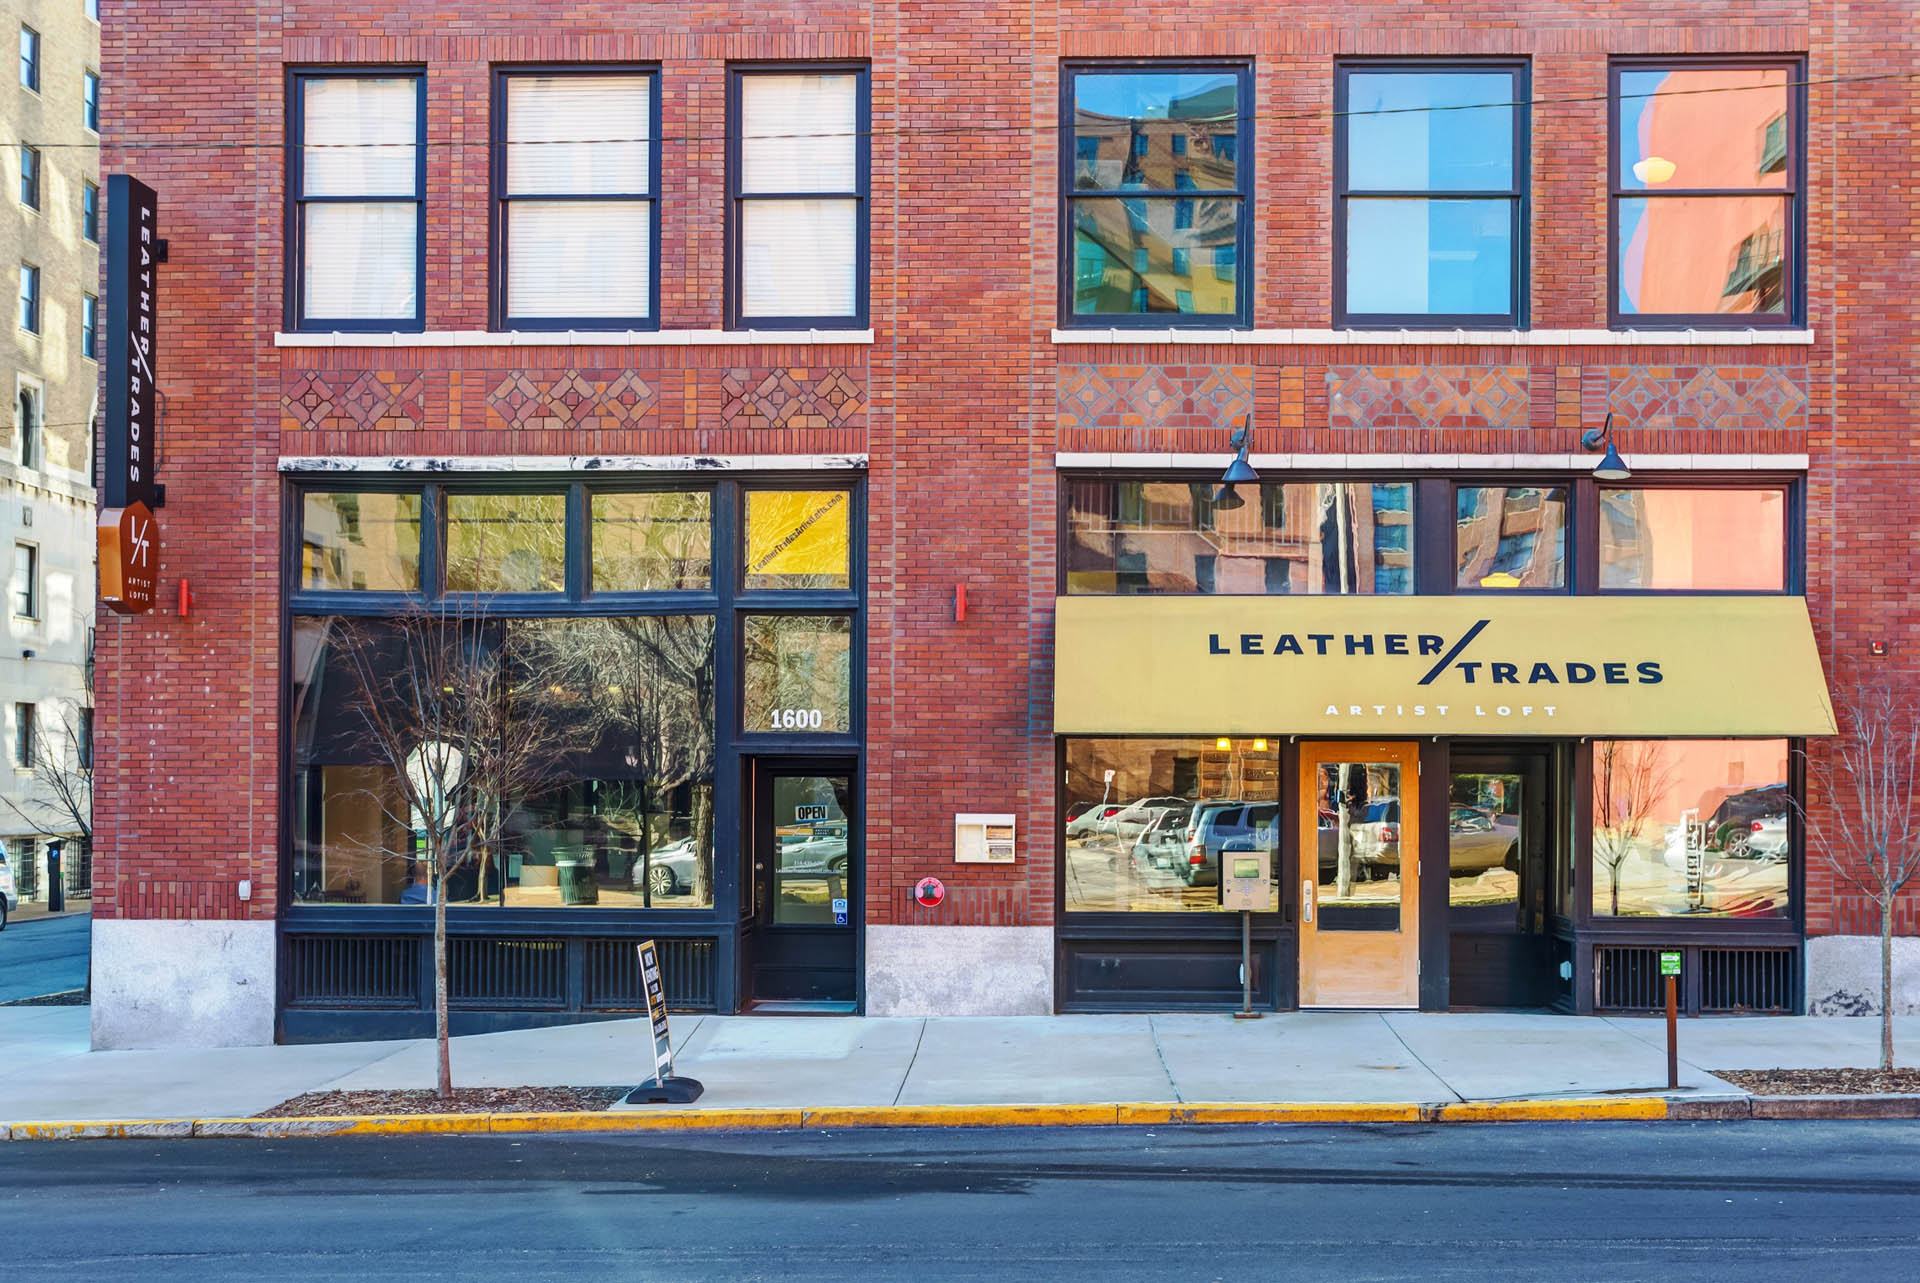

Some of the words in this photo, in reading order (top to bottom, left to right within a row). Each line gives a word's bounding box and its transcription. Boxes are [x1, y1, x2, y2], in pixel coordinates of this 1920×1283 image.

[128, 577, 150, 588] ARTIST
[129, 591, 149, 601] LOFTS
[1325, 705, 1449, 716] ARTIST
[1475, 705, 1557, 717] LOFT
[771, 709, 822, 729] 1600
[798, 806, 826, 819] OPEN
